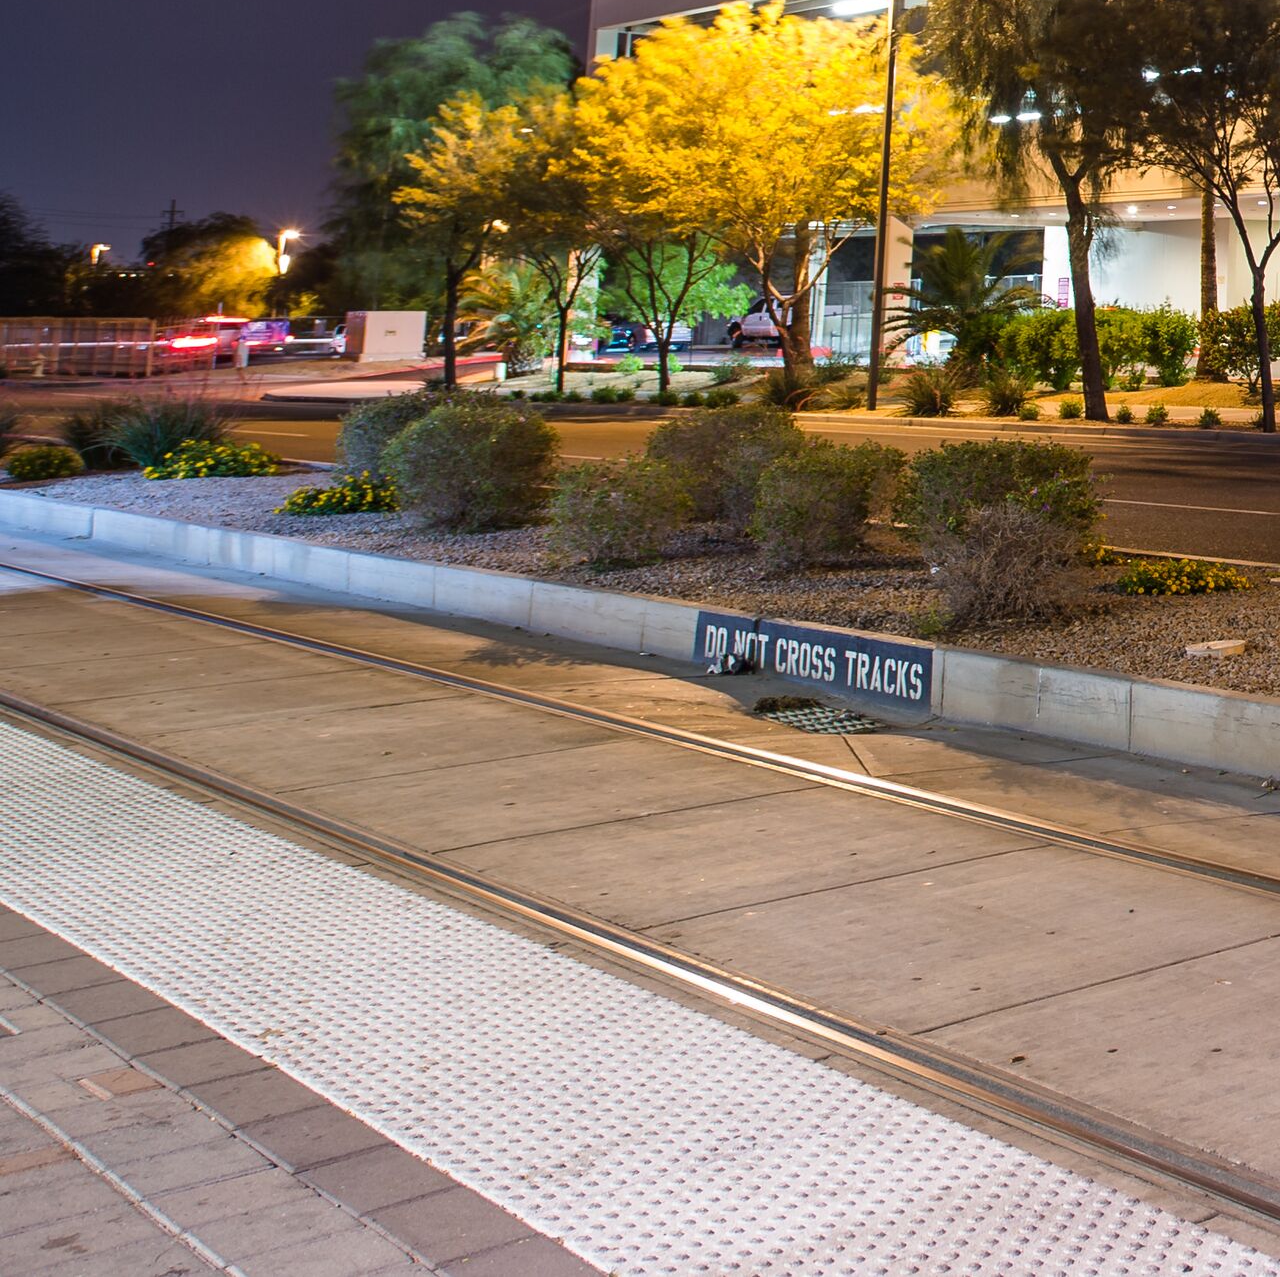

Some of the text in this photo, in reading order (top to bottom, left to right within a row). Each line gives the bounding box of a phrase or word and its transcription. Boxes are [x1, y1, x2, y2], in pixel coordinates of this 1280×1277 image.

[704, 624, 923, 700] DO NOT CROSS TRACKS
